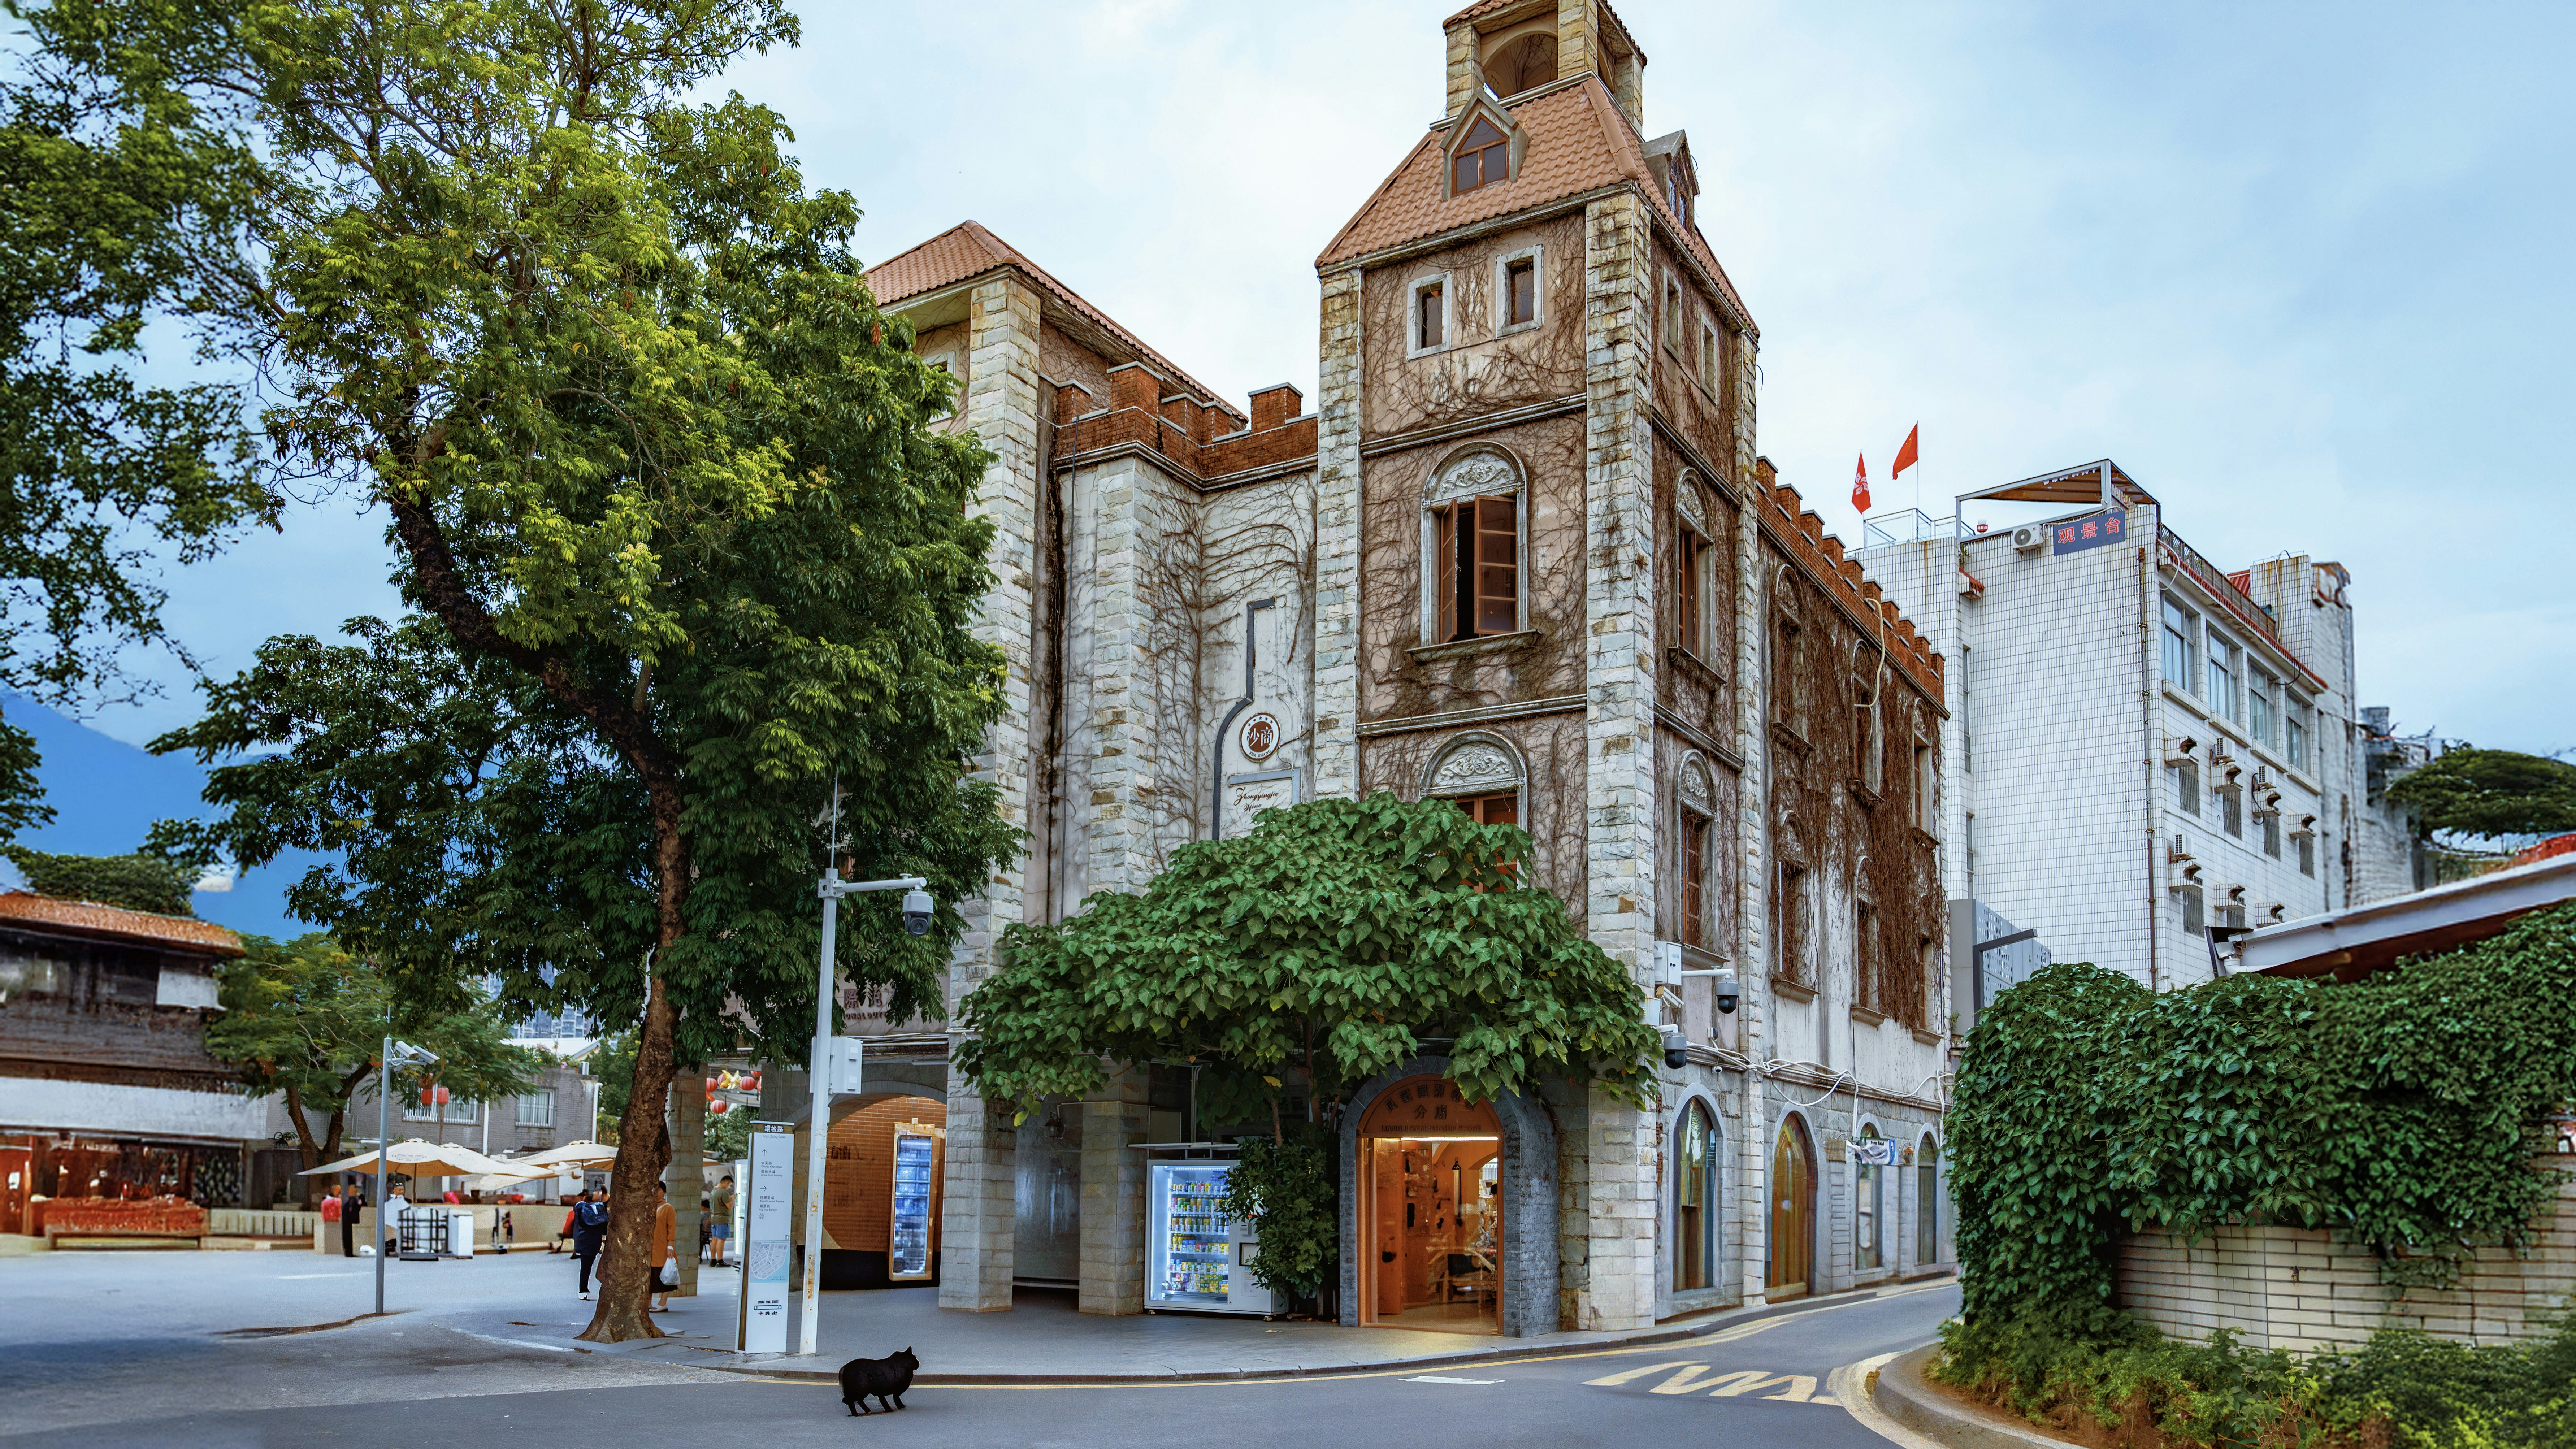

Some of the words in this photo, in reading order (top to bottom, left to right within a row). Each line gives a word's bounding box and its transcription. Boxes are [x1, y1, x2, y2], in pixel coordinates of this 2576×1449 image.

[2058, 517, 2120, 544] 观景台
[1246, 726, 1273, 747] 沙商
[1233, 786, 1279, 806] Zhongyingjie
